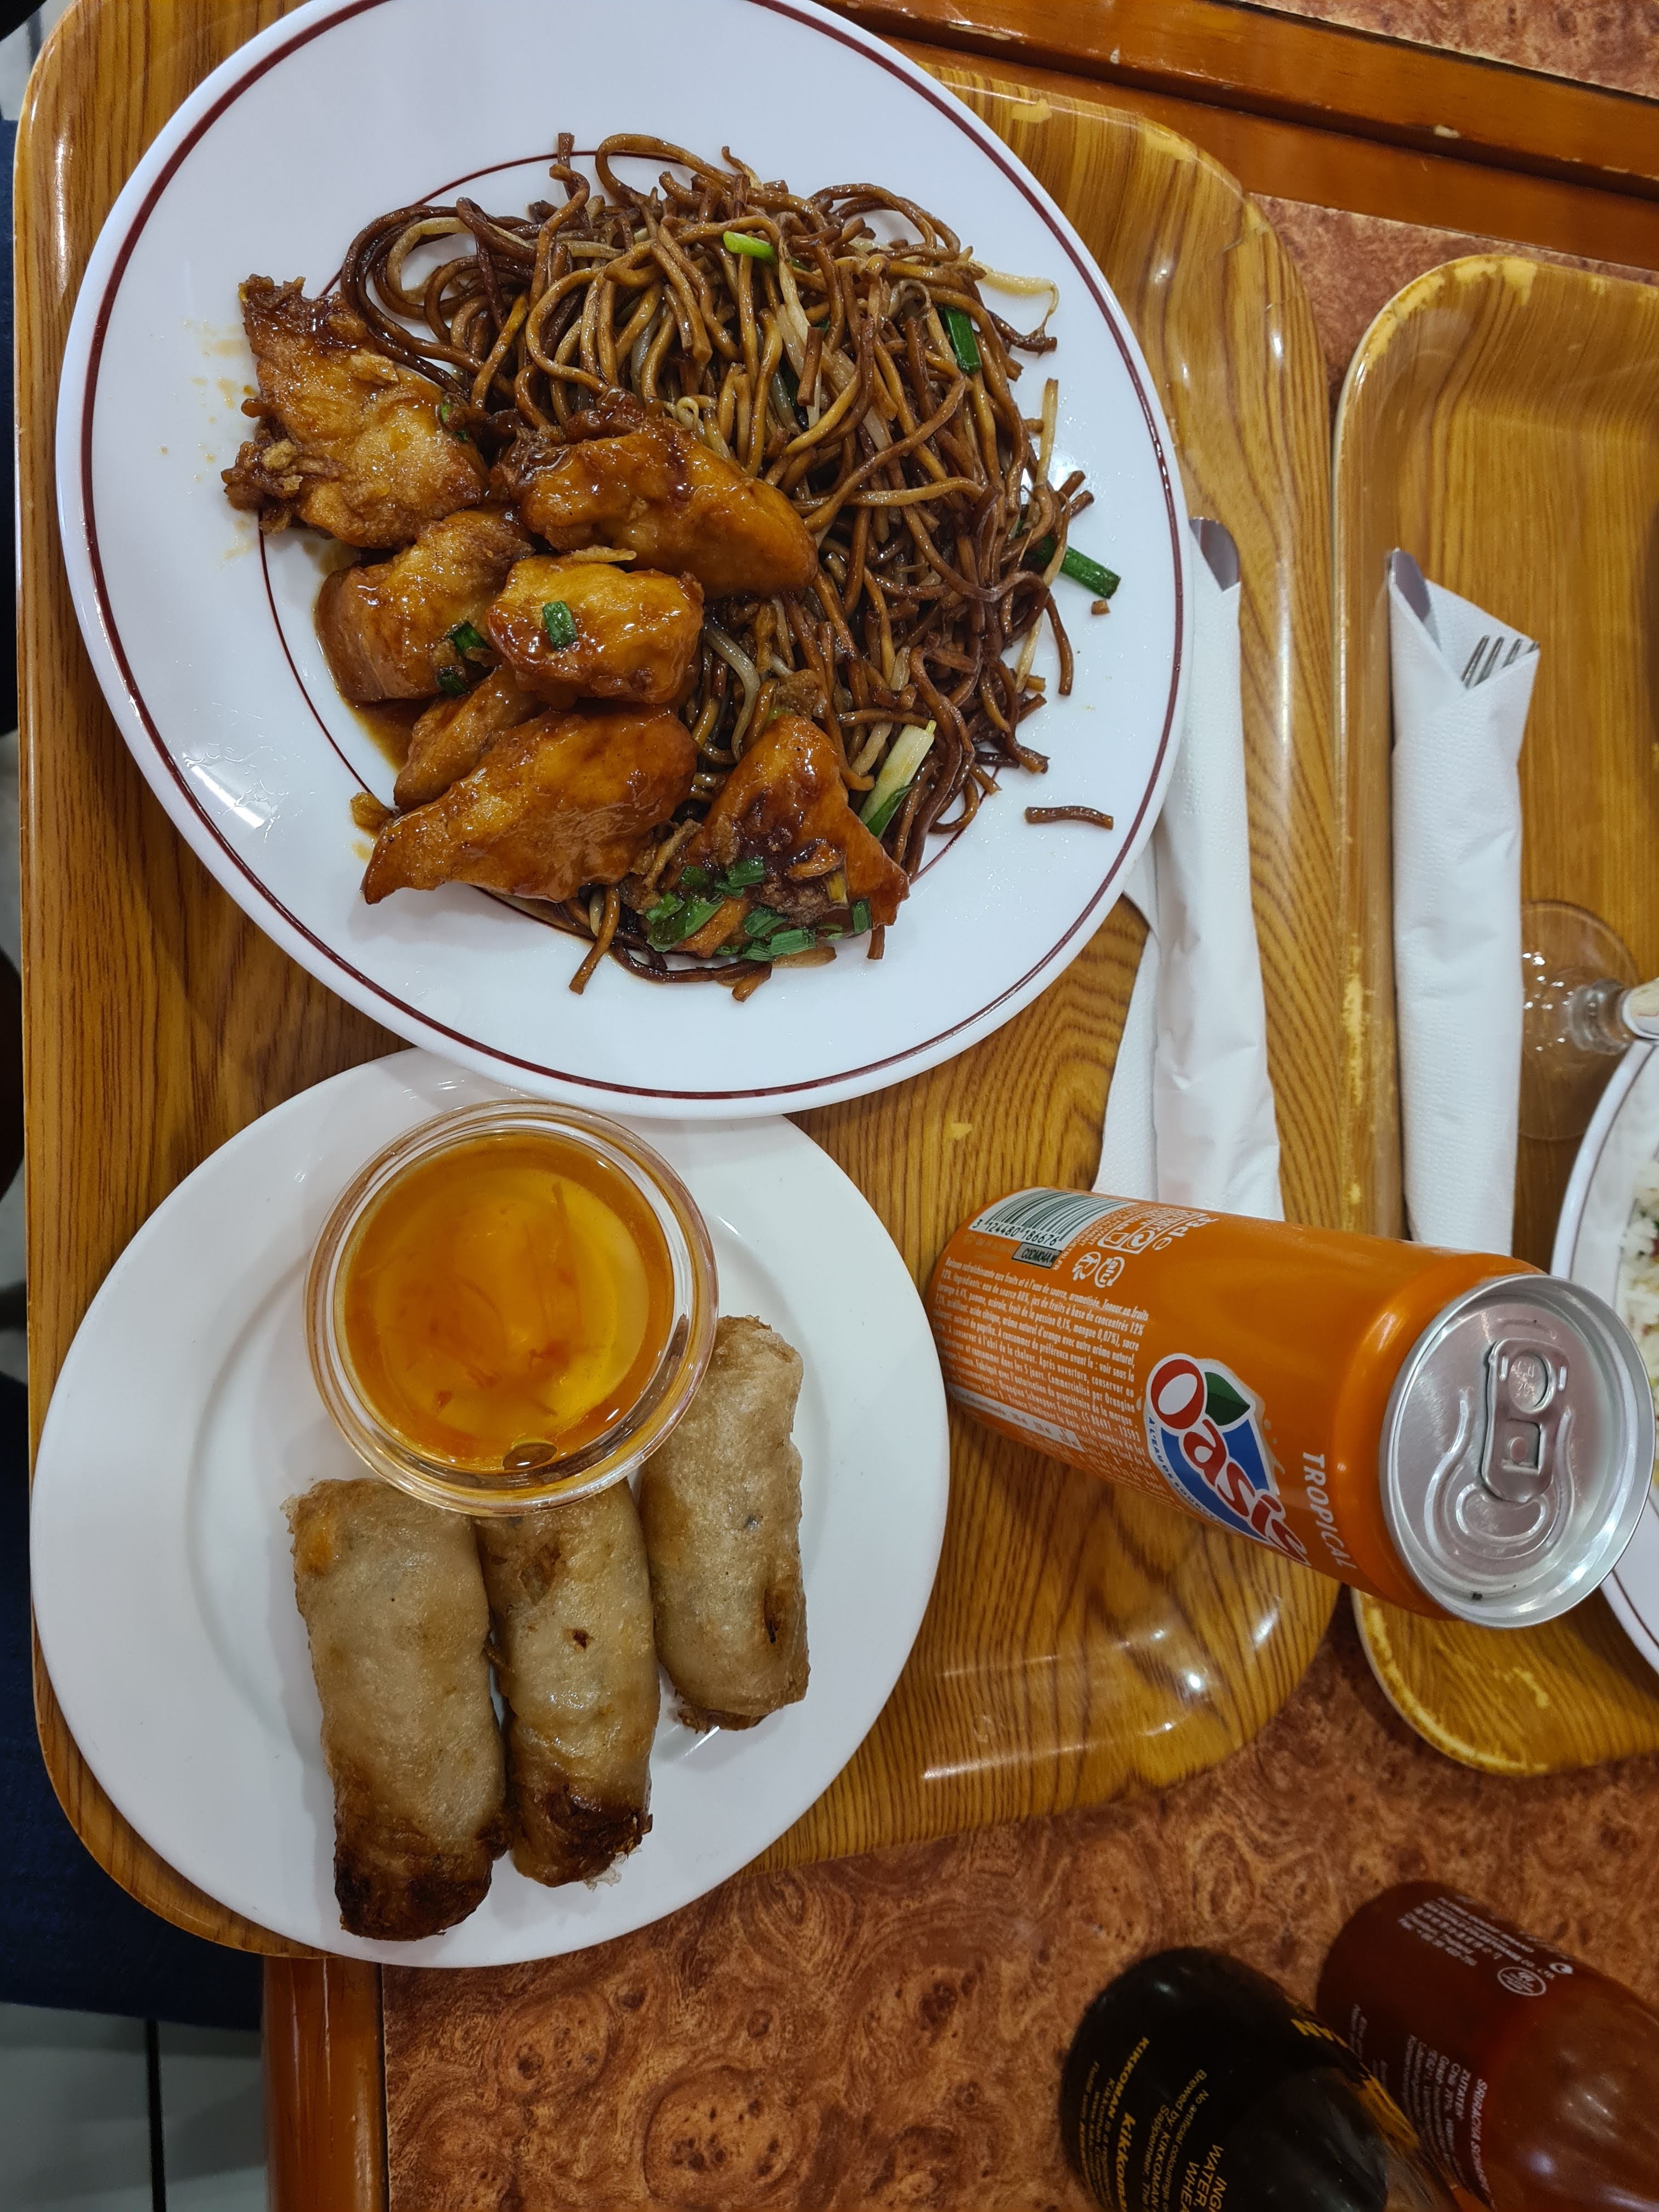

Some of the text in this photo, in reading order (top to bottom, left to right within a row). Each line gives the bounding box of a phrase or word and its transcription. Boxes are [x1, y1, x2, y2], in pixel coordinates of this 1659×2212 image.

[973, 1219, 983, 1228] 3
[985, 1222, 1021, 1237] 124480
[1022, 1229, 1059, 1246] 186676
[1005, 1272, 1018, 1284] fruits
[1018, 1278, 1025, 1287] et
[1042, 1283, 1049, 1294] de
[1049, 1288, 1068, 1300] source,
[1103, 1299, 1124, 1313] Teneur
[1122, 1308, 1131, 1316] en
[1131, 1306, 1149, 1321] fruits
[1099, 1261, 1118, 1283] alu
[992, 1284, 998, 1294] de
[999, 1288, 1017, 1299] source
[1031, 1295, 1041, 1307] jus
[1041, 1296, 1048, 1308] de
[1048, 1299, 1065, 1313] fruits
[1065, 1303, 1071, 1315] à
[1071, 1304, 1085, 1319] base
[1086, 1309, 1094, 1321] de
[1094, 1315, 1128, 1331] concentrés
[1130, 1322, 1146, 1336] 12%
[1008, 1301, 1020, 1315] fruit
[1021, 1306, 1028, 1317] de
[1029, 1306, 1035, 1319] la
[1035, 1313, 1056, 1325] passion
[1073, 1324, 1096, 1339] mangue
[1122, 1339, 1139, 1351] sucre
[970, 1318, 976, 1328] de
[1031, 1338, 1039, 1350] de
[1039, 1343, 1069, 1360] préférence
[1070, 1354, 1086, 1366] avant
[1087, 1355, 1093, 1369] le
[1099, 1362, 1111, 1374] voir
[1113, 1368, 1126, 1380] sous
[1128, 1368, 1135, 1383] la
[983, 1335, 998, 1350] l'abri
[999, 1340, 1006, 1353] de
[1007, 1344, 1013, 1355] la
[1015, 1346, 1037, 1364] chaleur.
[1039, 1356, 1056, 1371] Après
[1057, 1364, 1090, 1384] ouverture,
[1092, 1376, 1124, 1394] conserver
[1125, 1388, 1135, 1398] au
[1019, 1323, 1037, 1335] naturel
[1037, 1325, 1061, 1344] d'orange
[1062, 1336, 1075, 1347] avec
[1075, 1340, 1091, 1352] autre
[1092, 1345, 1110, 1358] arôme
[1111, 1352, 1135, 1369] naturel,
[1001, 1355, 1013, 1369] dans
[1014, 1358, 1023, 1372] les
[1024, 1363, 1028, 1374] 5
[1030, 1365, 1046, 1381] jours.
[1048, 1372, 1090, 1397] Commercialisé
[1092, 1390, 1102, 1401] par
[1105, 1392, 1135, 1413] Orangina
[1048, 1384, 1054, 1397] du
[1056, 1391, 1090, 1410] propriétaire
[1092, 1401, 1099, 1414] de
[1100, 1403, 1107, 1417] la
[1081, 1411, 1090, 1422] CS
[1125, 1439, 1133, 1451] de
[1150, 1359, 1311, 1566] Oasis
[1162, 1465, 1173, 1479] DE
[1302, 1452, 1357, 1570] TROPICAL
[1108, 2036, 1149, 2118] KIKKOMAN
[1175, 2069, 1207, 2111] Brewed
[1195, 2090, 1209, 2104] No
[1176, 2104, 1197, 2145] artificial
[1471, 2078, 1488, 2141] SRIRACHA
[1152, 2131, 1171, 2208] KIKKOMAN
[1194, 2144, 1224, 2207] WATER,
